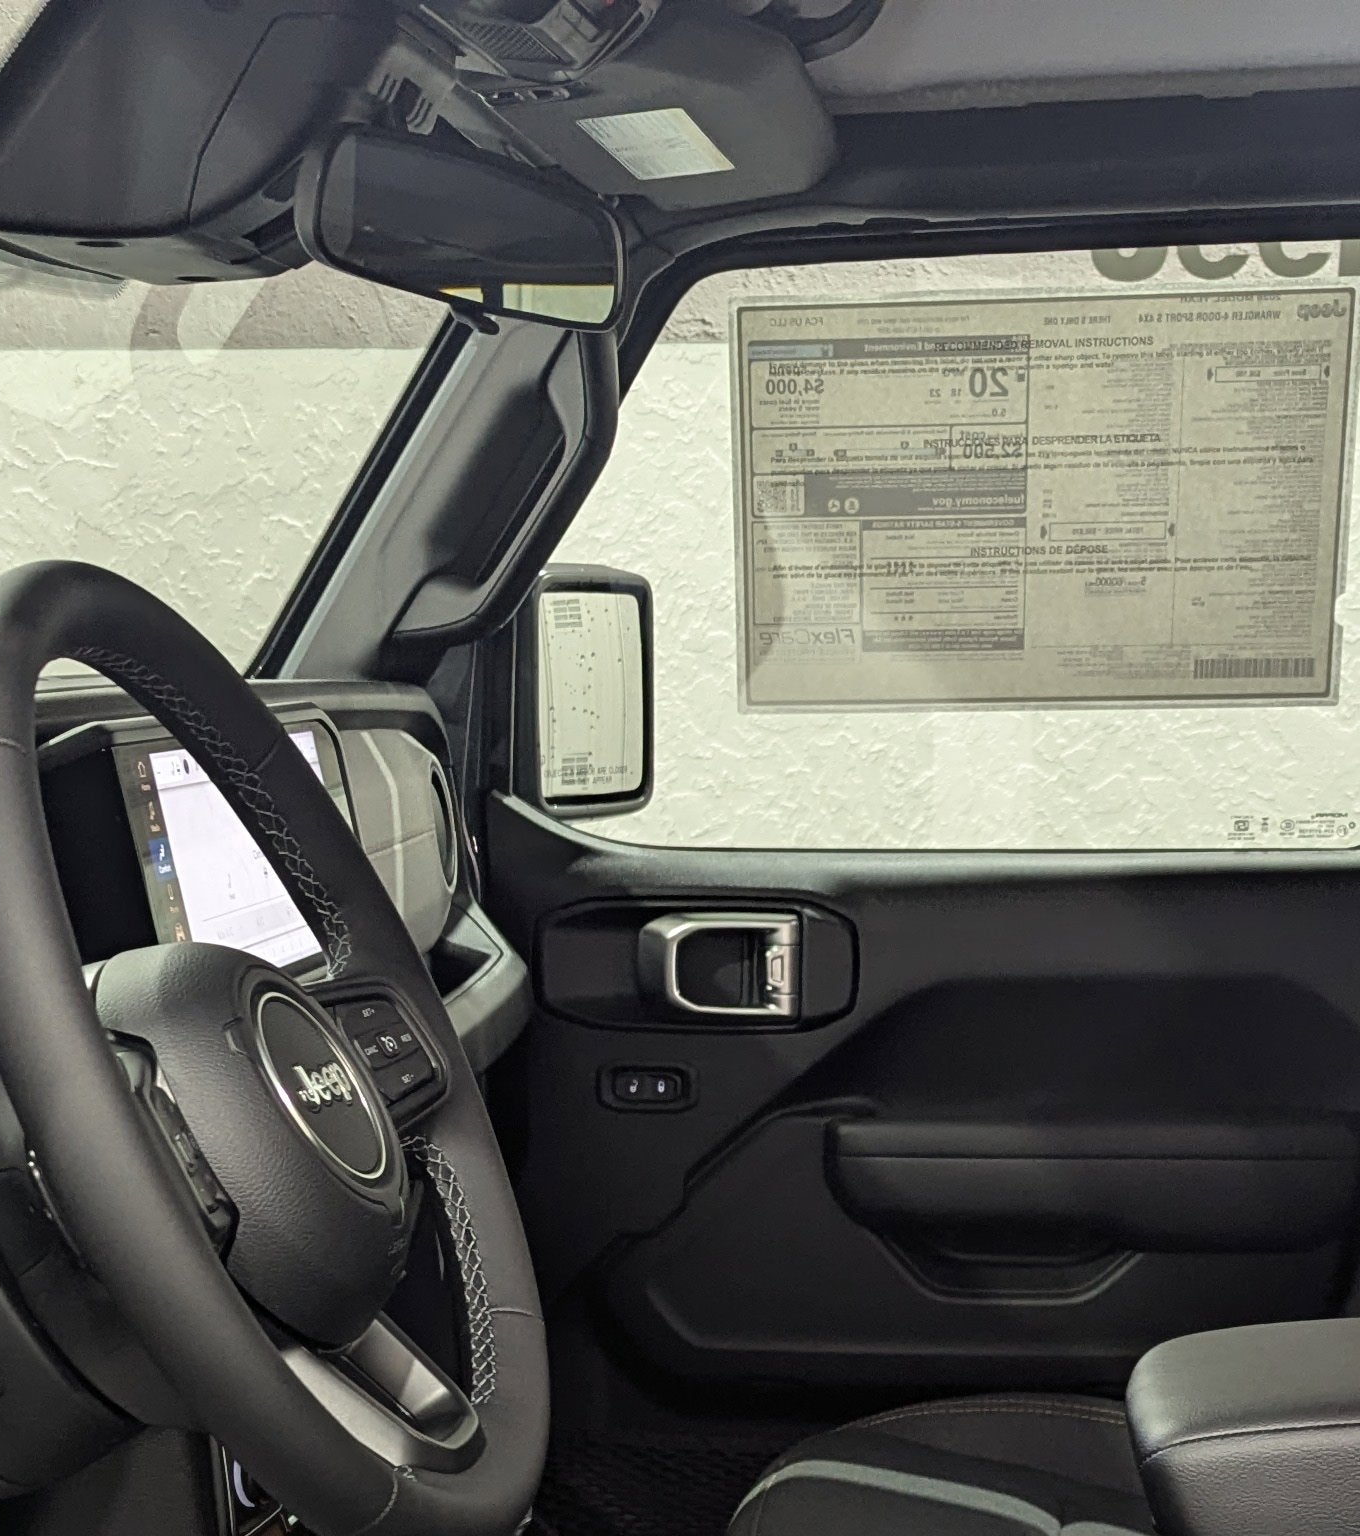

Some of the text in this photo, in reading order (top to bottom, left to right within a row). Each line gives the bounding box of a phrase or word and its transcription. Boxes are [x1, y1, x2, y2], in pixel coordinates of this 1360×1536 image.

[1020, 337, 1073, 349] REMOVAL
[1074, 335, 1154, 348] INSTRUCTIONS
[1031, 433, 1098, 446] DESPRENDER
[1099, 434, 1113, 444] LA
[970, 545, 1047, 558] INSTRUCTIONS
[1048, 545, 1063, 555] DE
[292, 1061, 353, 1106] Jeep
